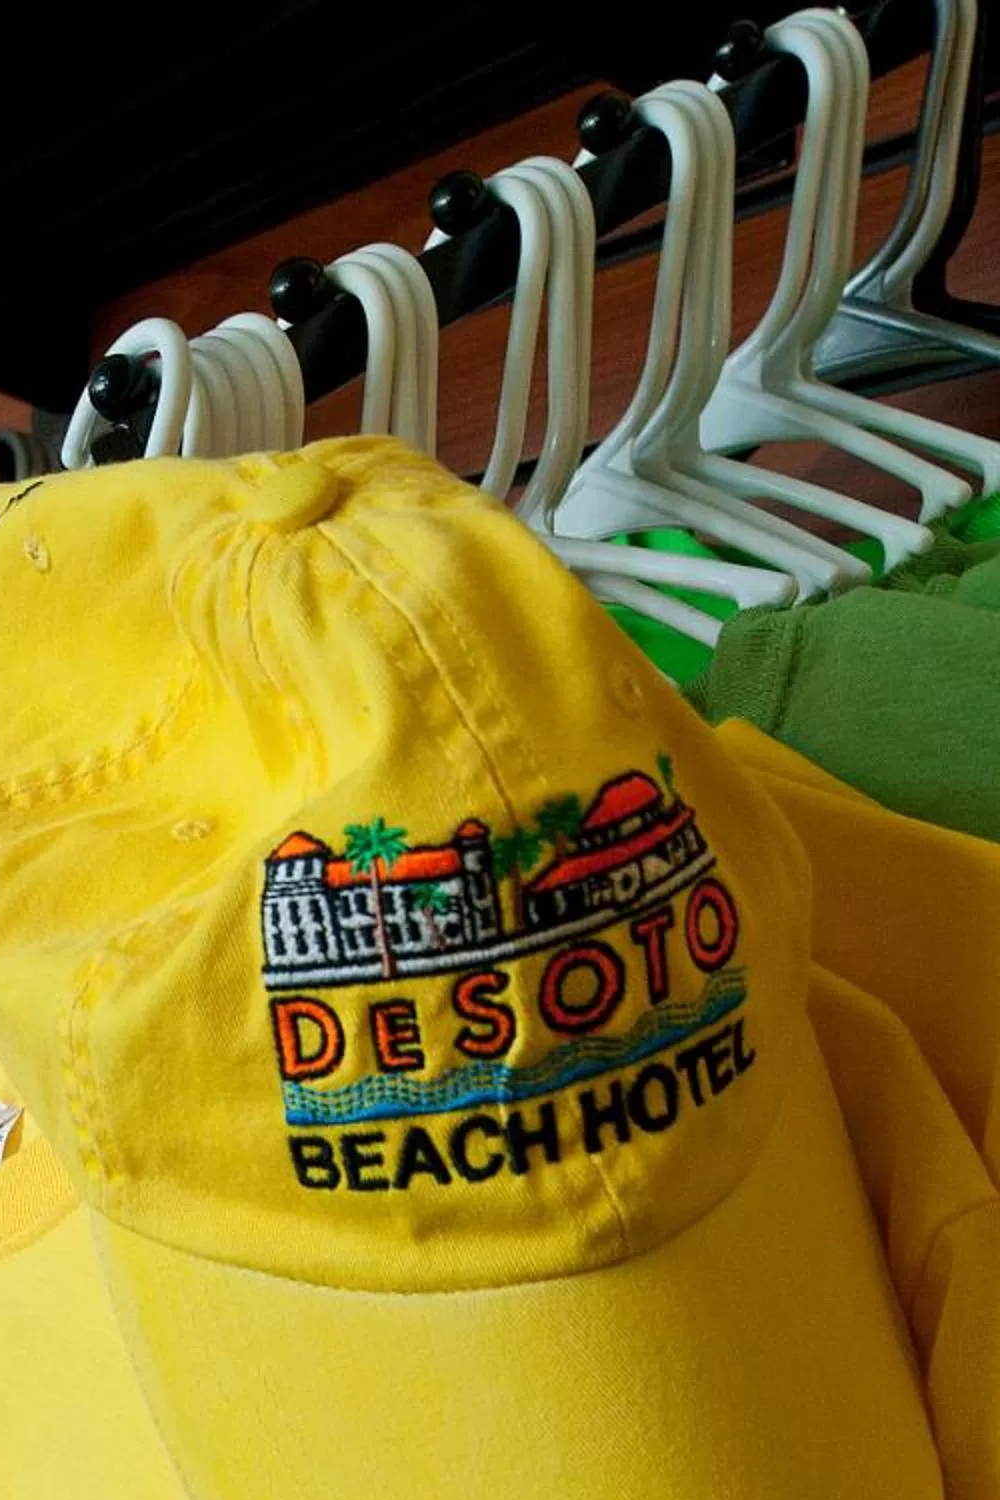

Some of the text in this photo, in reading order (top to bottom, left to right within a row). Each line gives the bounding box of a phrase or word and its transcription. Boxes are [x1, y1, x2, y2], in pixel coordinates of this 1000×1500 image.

[271, 876, 739, 1082] DESOTO
[287, 1017, 757, 1193] BEACH HOTEL
